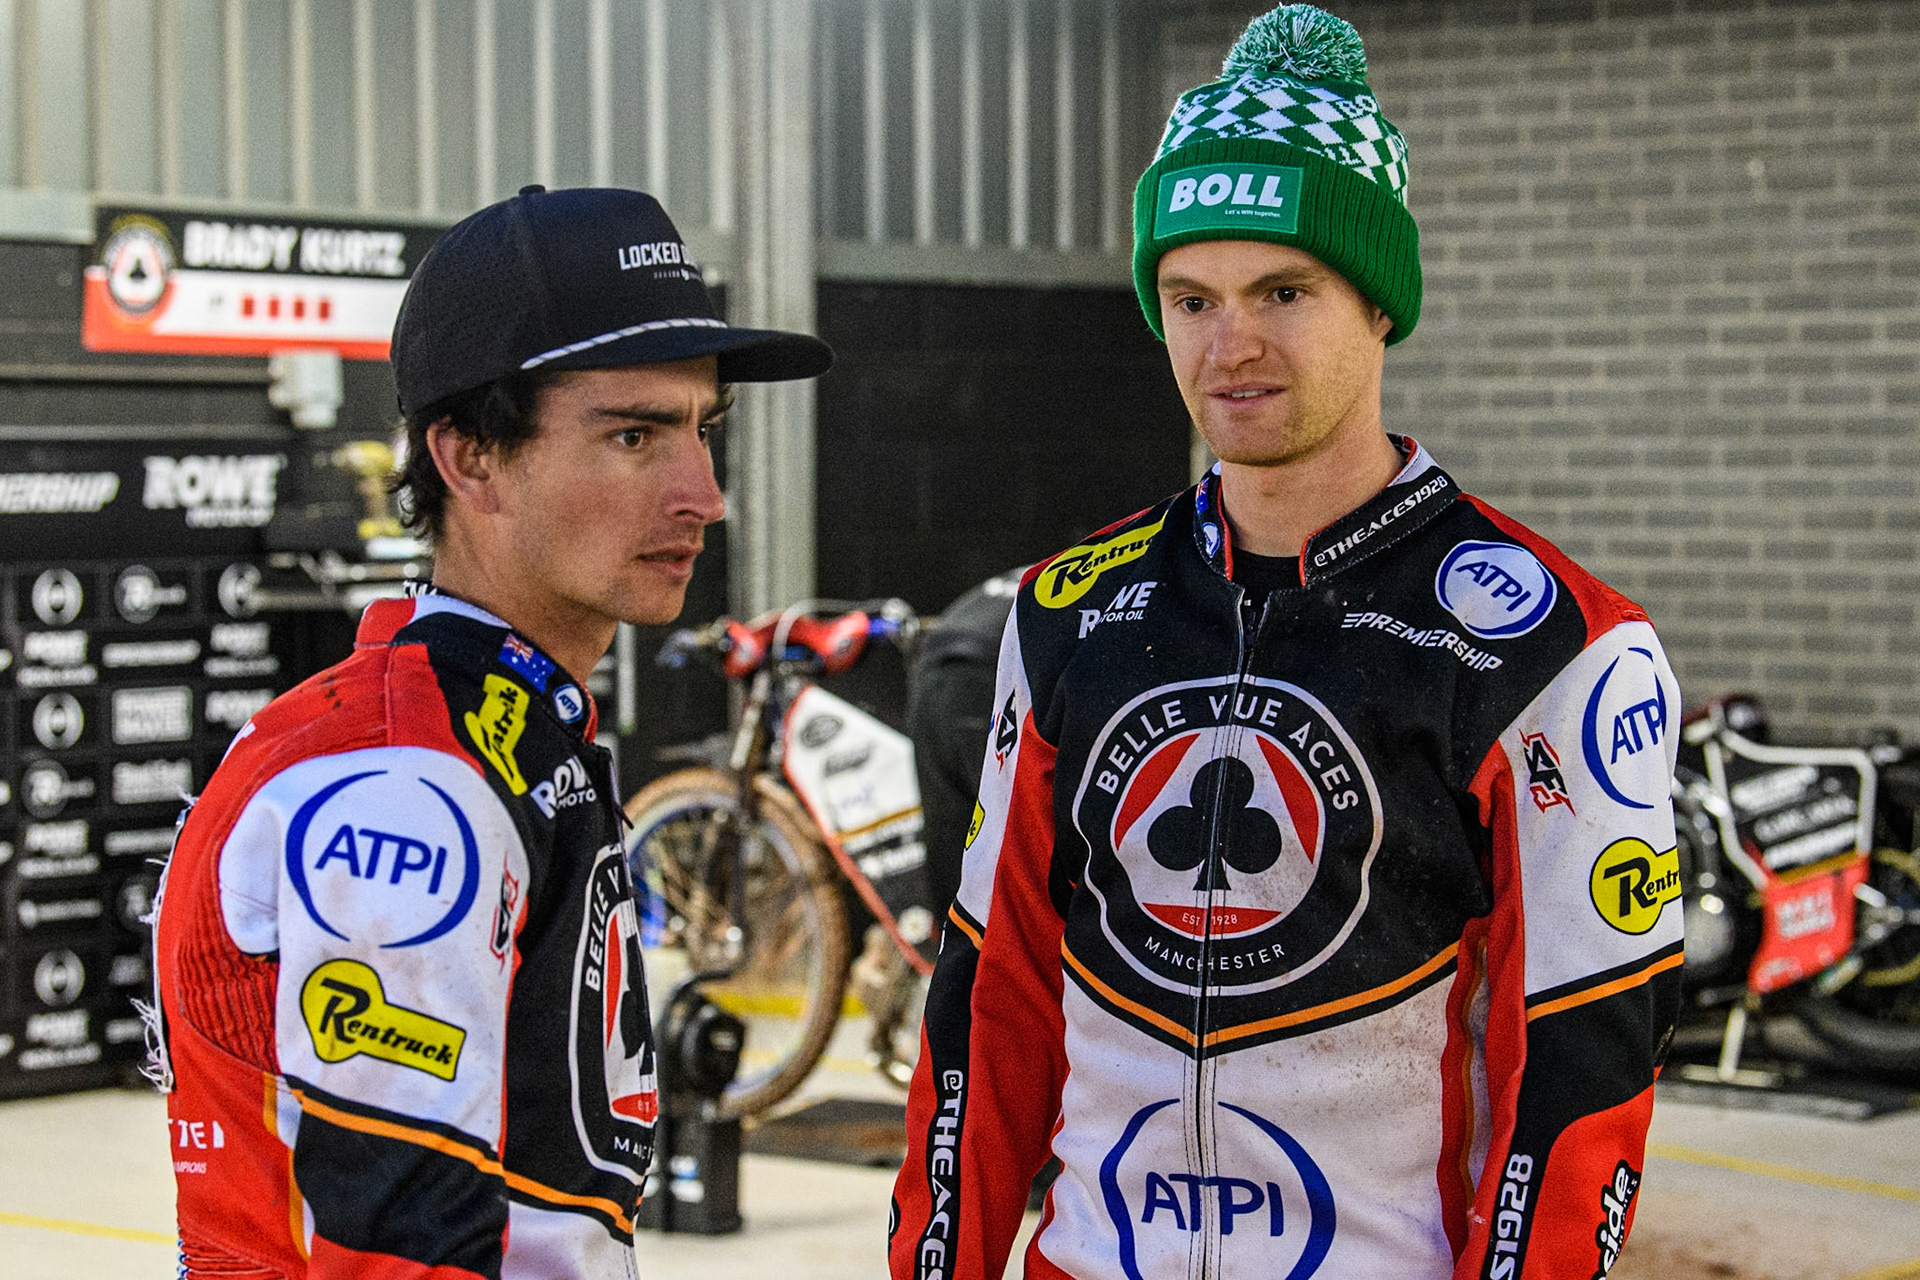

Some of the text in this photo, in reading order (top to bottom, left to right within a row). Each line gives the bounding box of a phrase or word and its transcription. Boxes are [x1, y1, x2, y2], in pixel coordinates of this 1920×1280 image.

[1169, 173, 1283, 213] BOLL
[618, 242, 681, 270] LOCKED
[143, 455, 279, 509] ROWE
[1046, 537, 1152, 599] Rentru
[1455, 561, 1532, 612] ATPI
[1125, 610, 1144, 621] OIL
[1096, 693, 1359, 811] BELLE VUE ACES
[1611, 699, 1662, 764] ATP
[315, 824, 447, 894] ATPI
[1182, 913, 1238, 927] EST 1928
[1145, 936, 1285, 971] MANCHESTER
[320, 977, 454, 1065] Rentruck
[1141, 1172, 1284, 1237] ATPI
